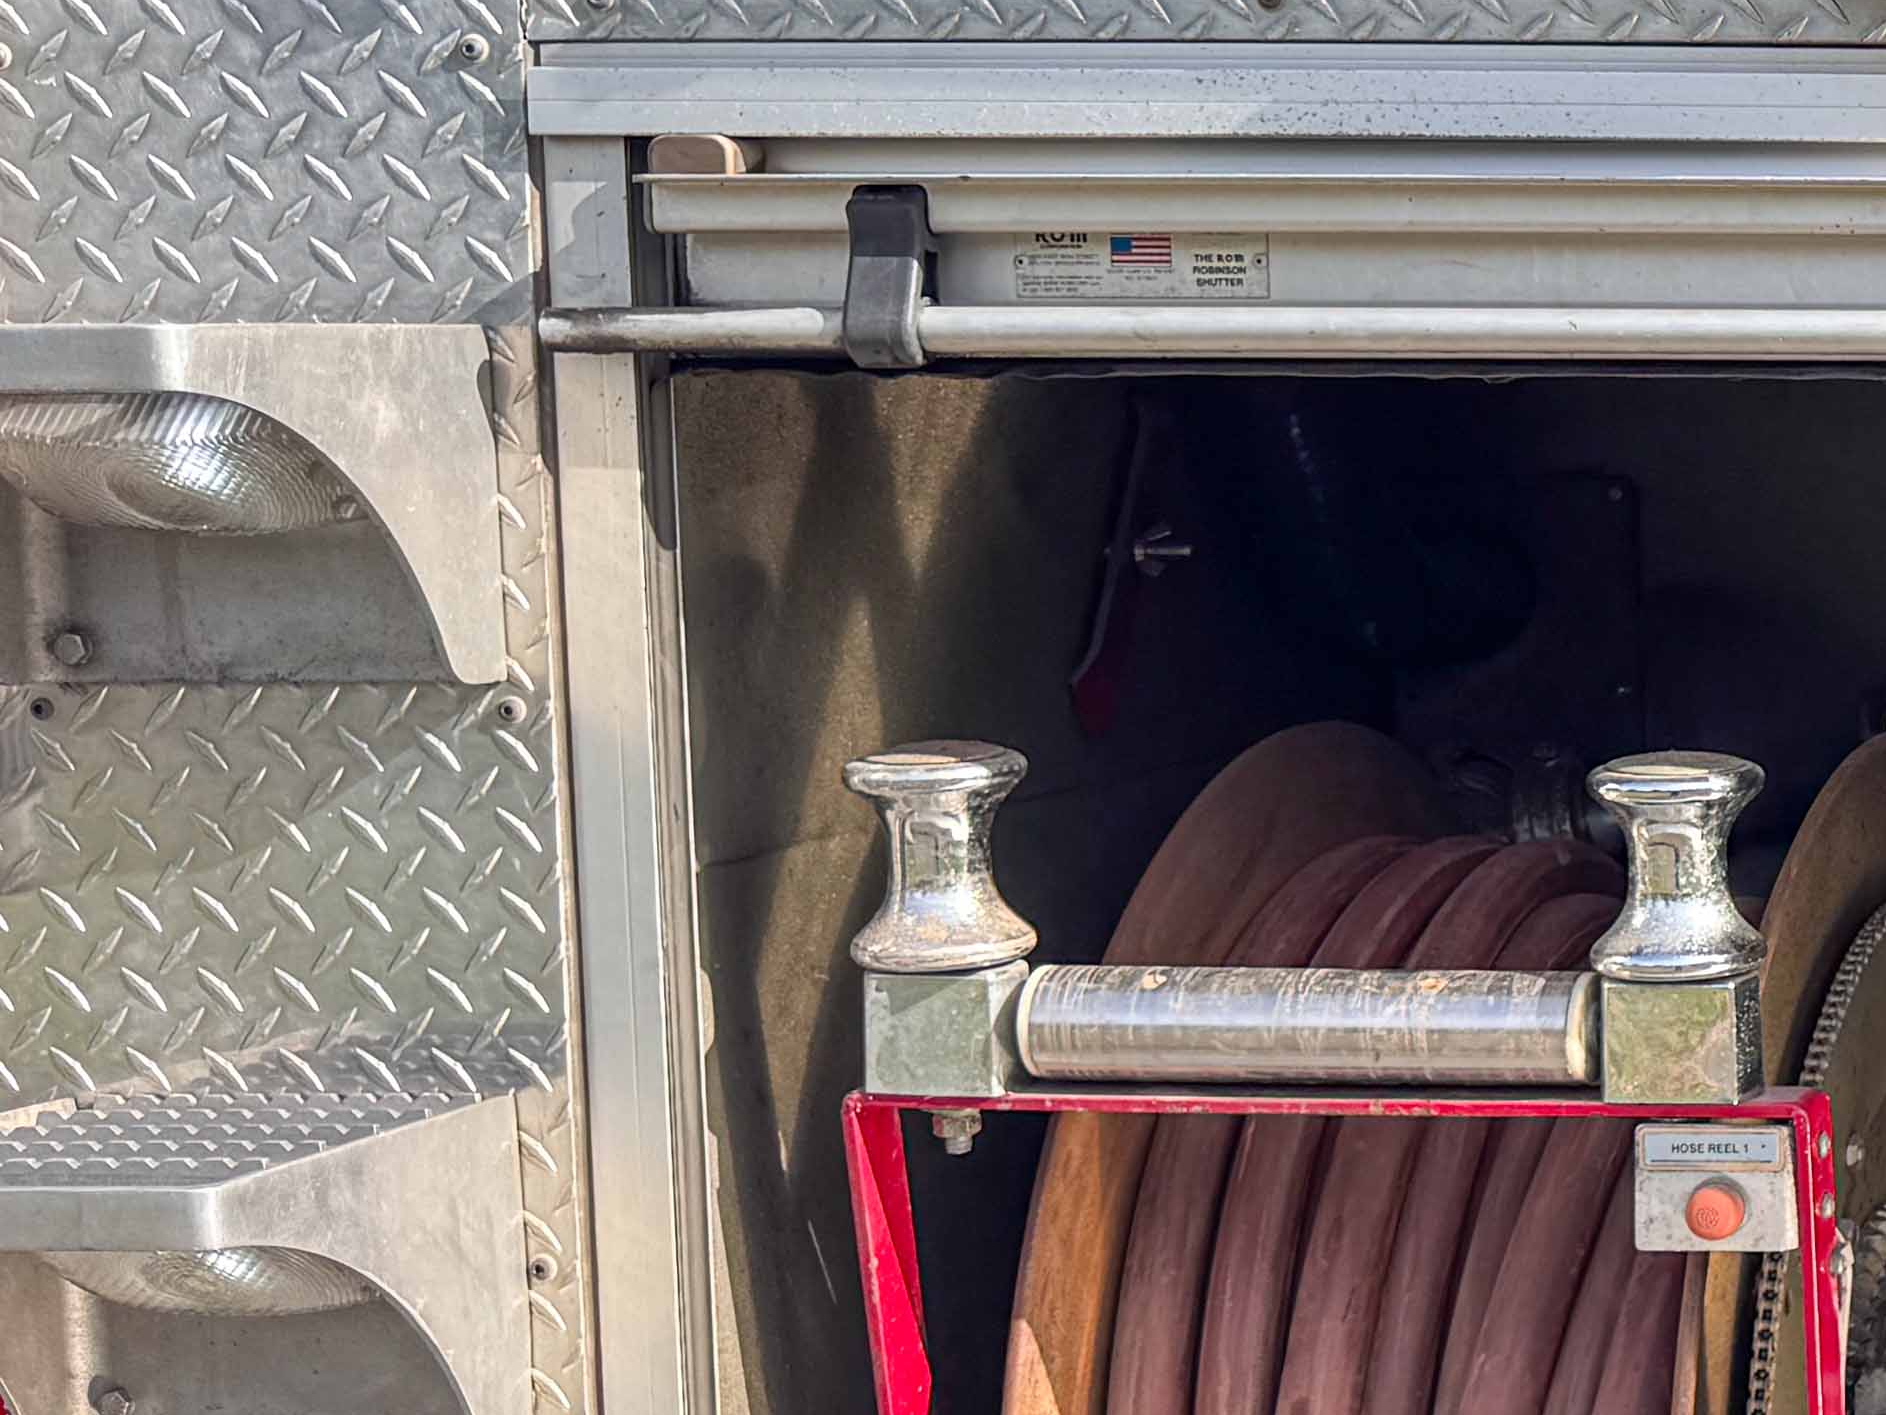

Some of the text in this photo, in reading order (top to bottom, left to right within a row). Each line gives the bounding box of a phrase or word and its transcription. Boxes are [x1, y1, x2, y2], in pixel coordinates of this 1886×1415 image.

[1194, 253, 1214, 263] THE
[1193, 265, 1247, 275] ROBINSON
[1196, 277, 1244, 287] SHUTTER
[1671, 1142, 1749, 1154] HOSE REEL 1
